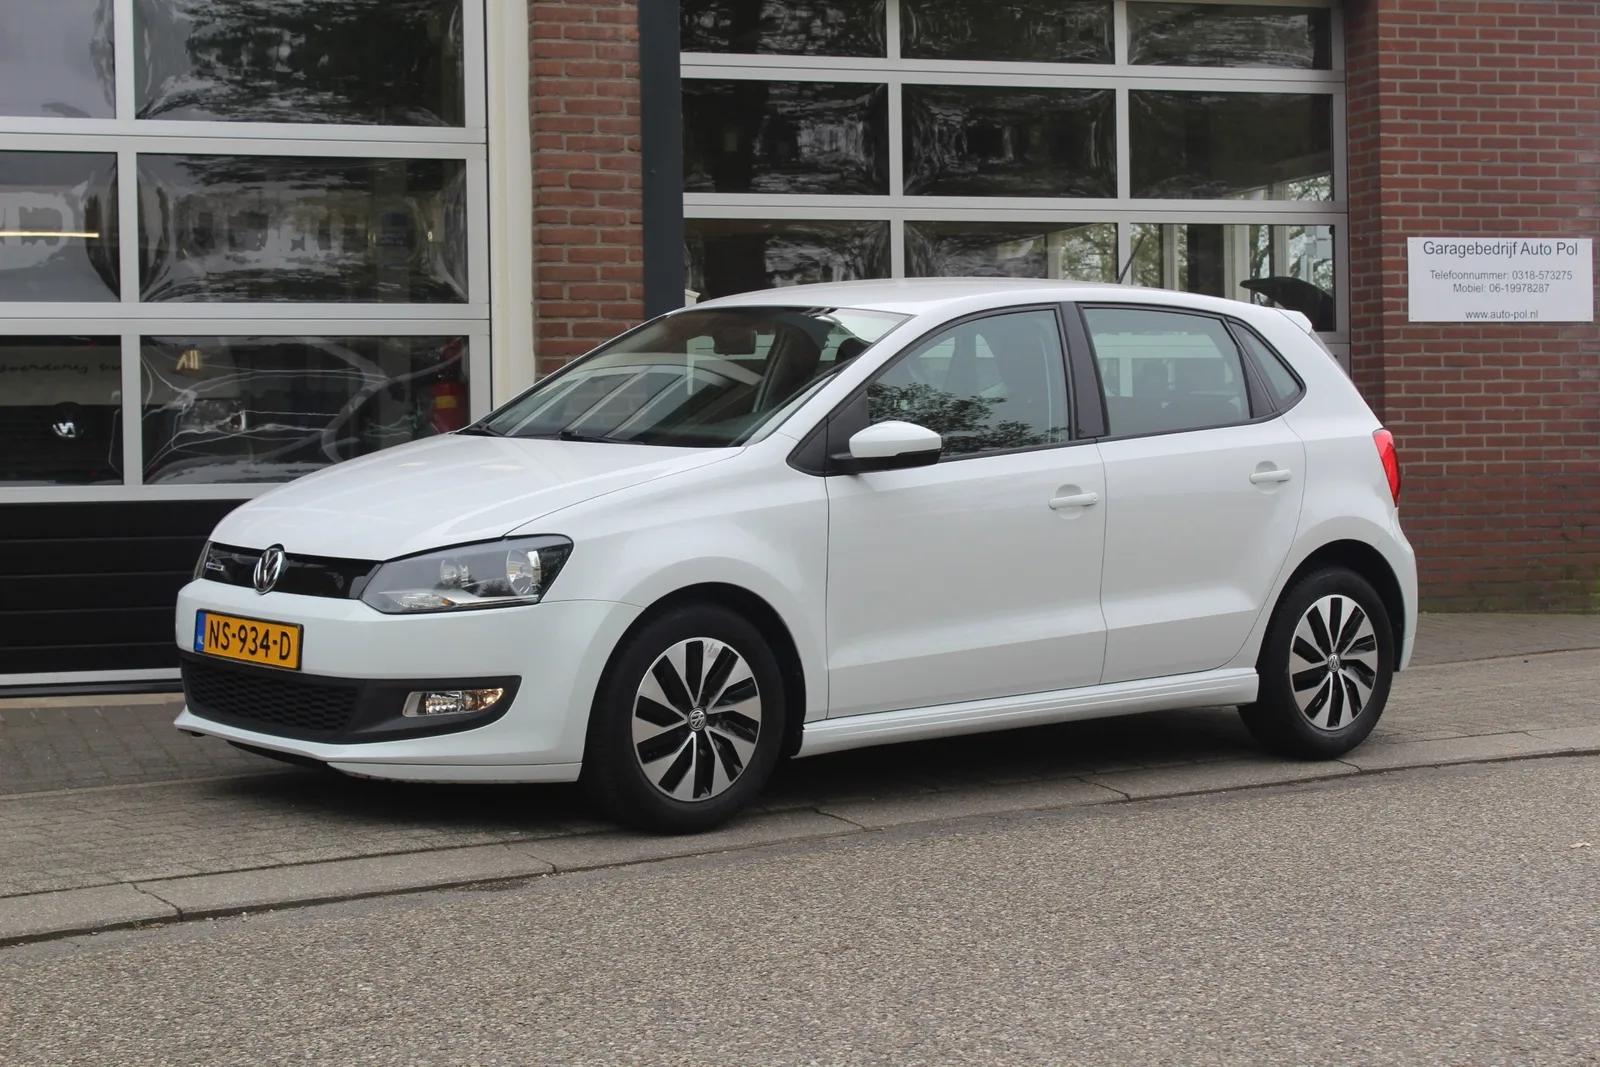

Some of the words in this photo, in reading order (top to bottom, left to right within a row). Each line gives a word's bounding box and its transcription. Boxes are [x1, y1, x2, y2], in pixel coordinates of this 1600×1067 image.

[1423, 240, 1517, 258] Garagebedrijf
[1520, 242, 1552, 256] Auto
[1556, 242, 1578, 256] Pol
[1430, 270, 1509, 280] Telefoonnummer:
[1512, 270, 1573, 281] 0318-573275
[1453, 283, 1486, 293] Mobiel:
[1489, 283, 1550, 293] 06-19978287
[1465, 309, 1539, 321] www.auto-pol.nl
[208, 619, 292, 661] NS-934-D
